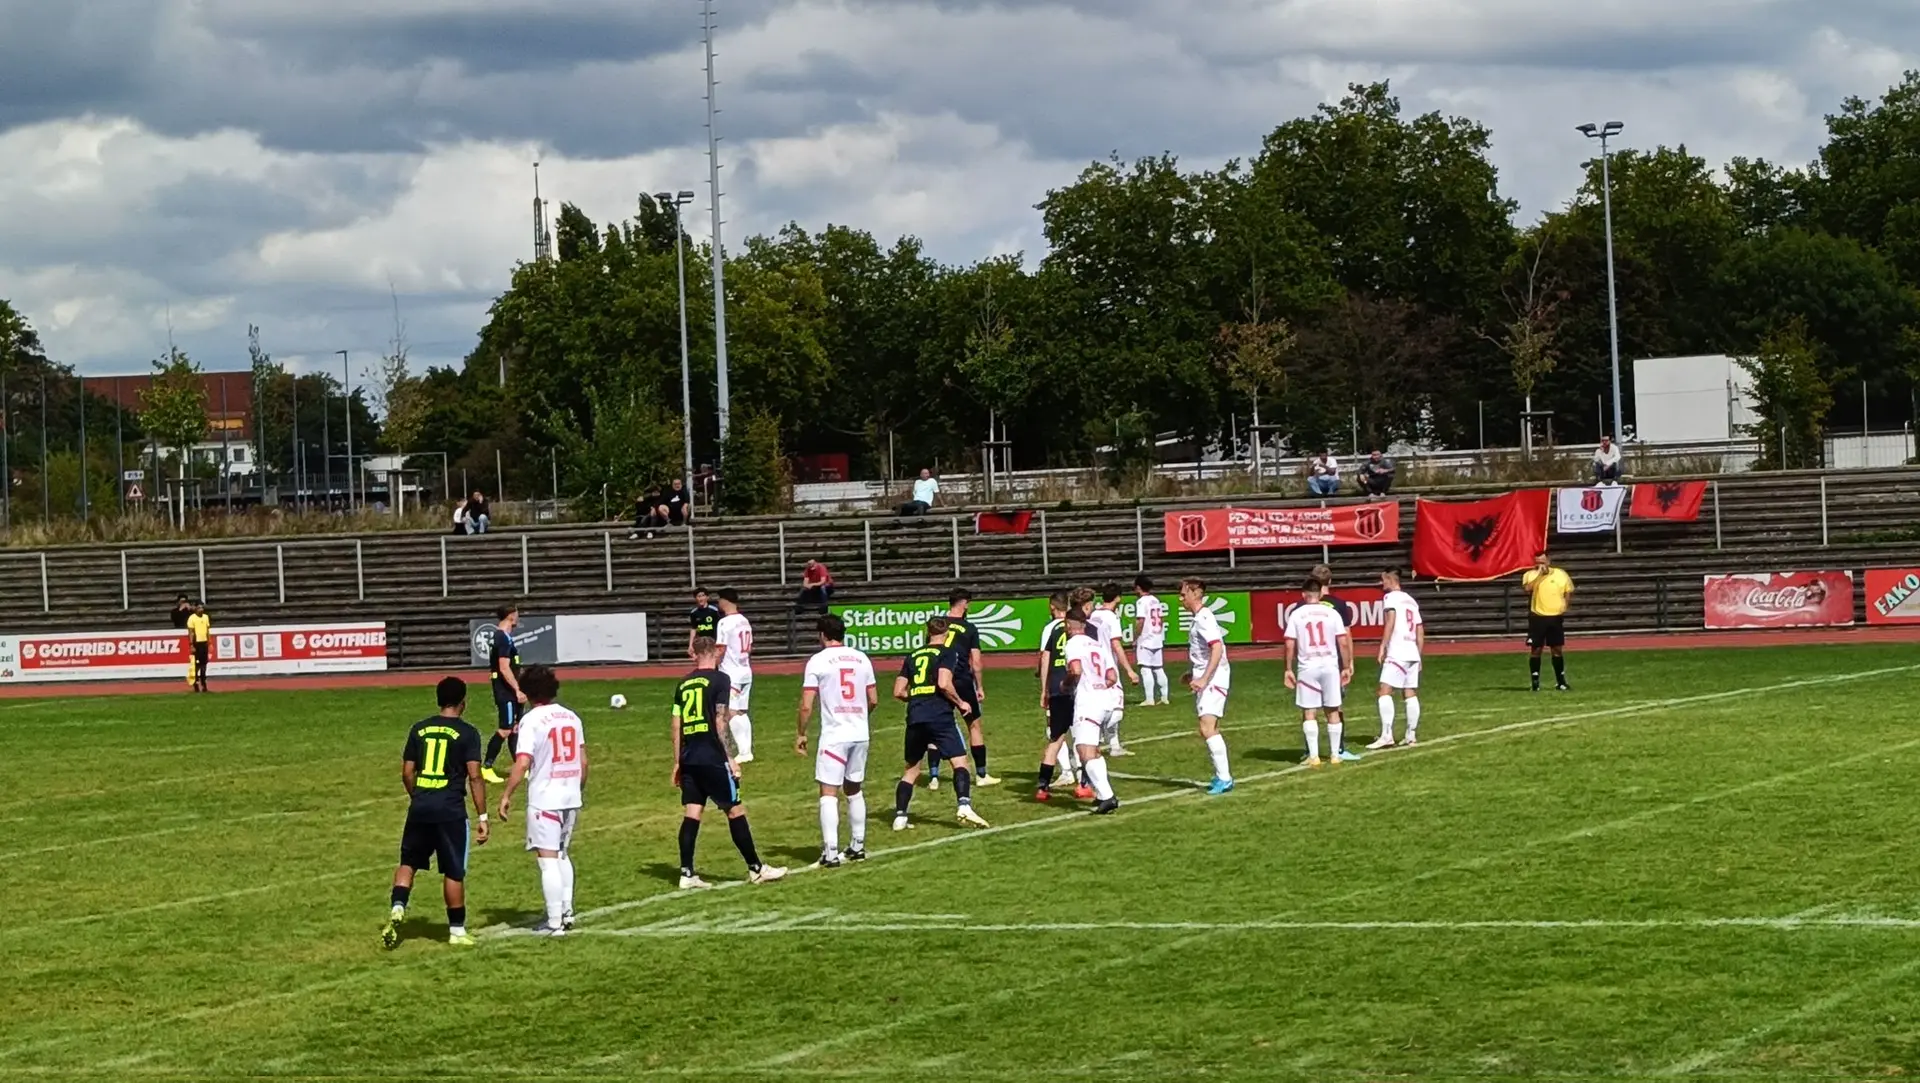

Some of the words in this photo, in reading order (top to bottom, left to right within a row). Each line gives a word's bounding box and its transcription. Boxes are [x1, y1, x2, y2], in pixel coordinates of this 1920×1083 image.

[842, 605, 949, 628] Stadtwerk
[39, 640, 116, 658] GOTTFRIED
[118, 639, 181, 655] SCHULTZ
[843, 630, 924, 651] Düsseld
[1304, 620, 1327, 647] 11
[839, 668, 856, 700] 5
[913, 655, 929, 685] 3
[682, 687, 705, 724] 21
[421, 737, 448, 776] 11
[548, 725, 576, 764] 19
